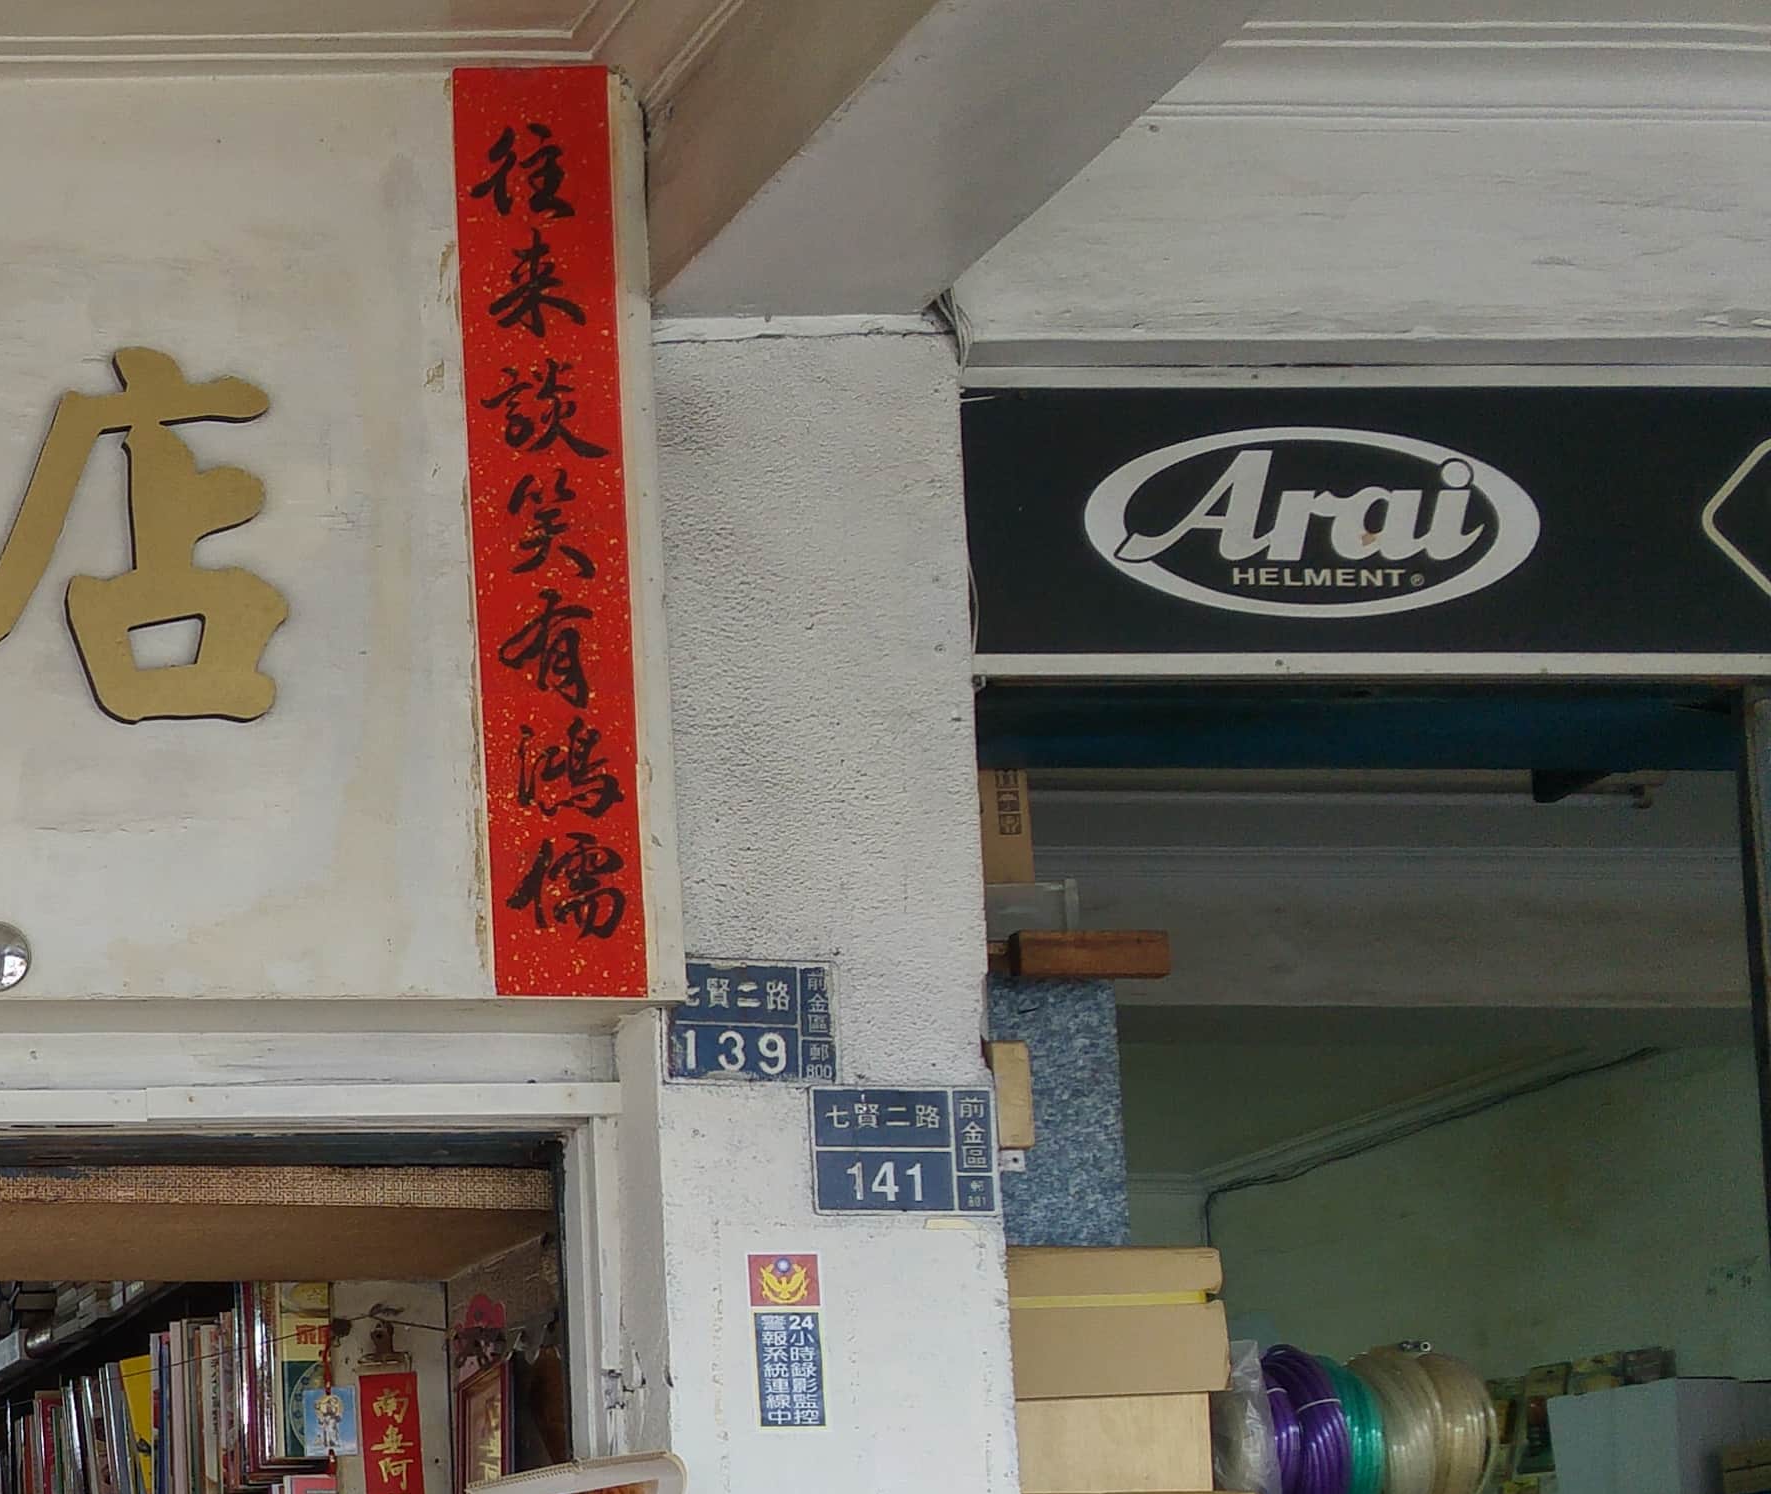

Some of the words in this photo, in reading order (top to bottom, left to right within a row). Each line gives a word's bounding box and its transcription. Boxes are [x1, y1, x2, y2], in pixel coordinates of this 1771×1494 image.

[1114, 449, 1485, 563] Arai
[1231, 566, 1405, 588] HELMENT
[683, 1029, 787, 1075] 139
[825, 1100, 941, 1129] 七賢二路
[958, 1097, 988, 1169] 前金區
[846, 1161, 924, 1202] 141
